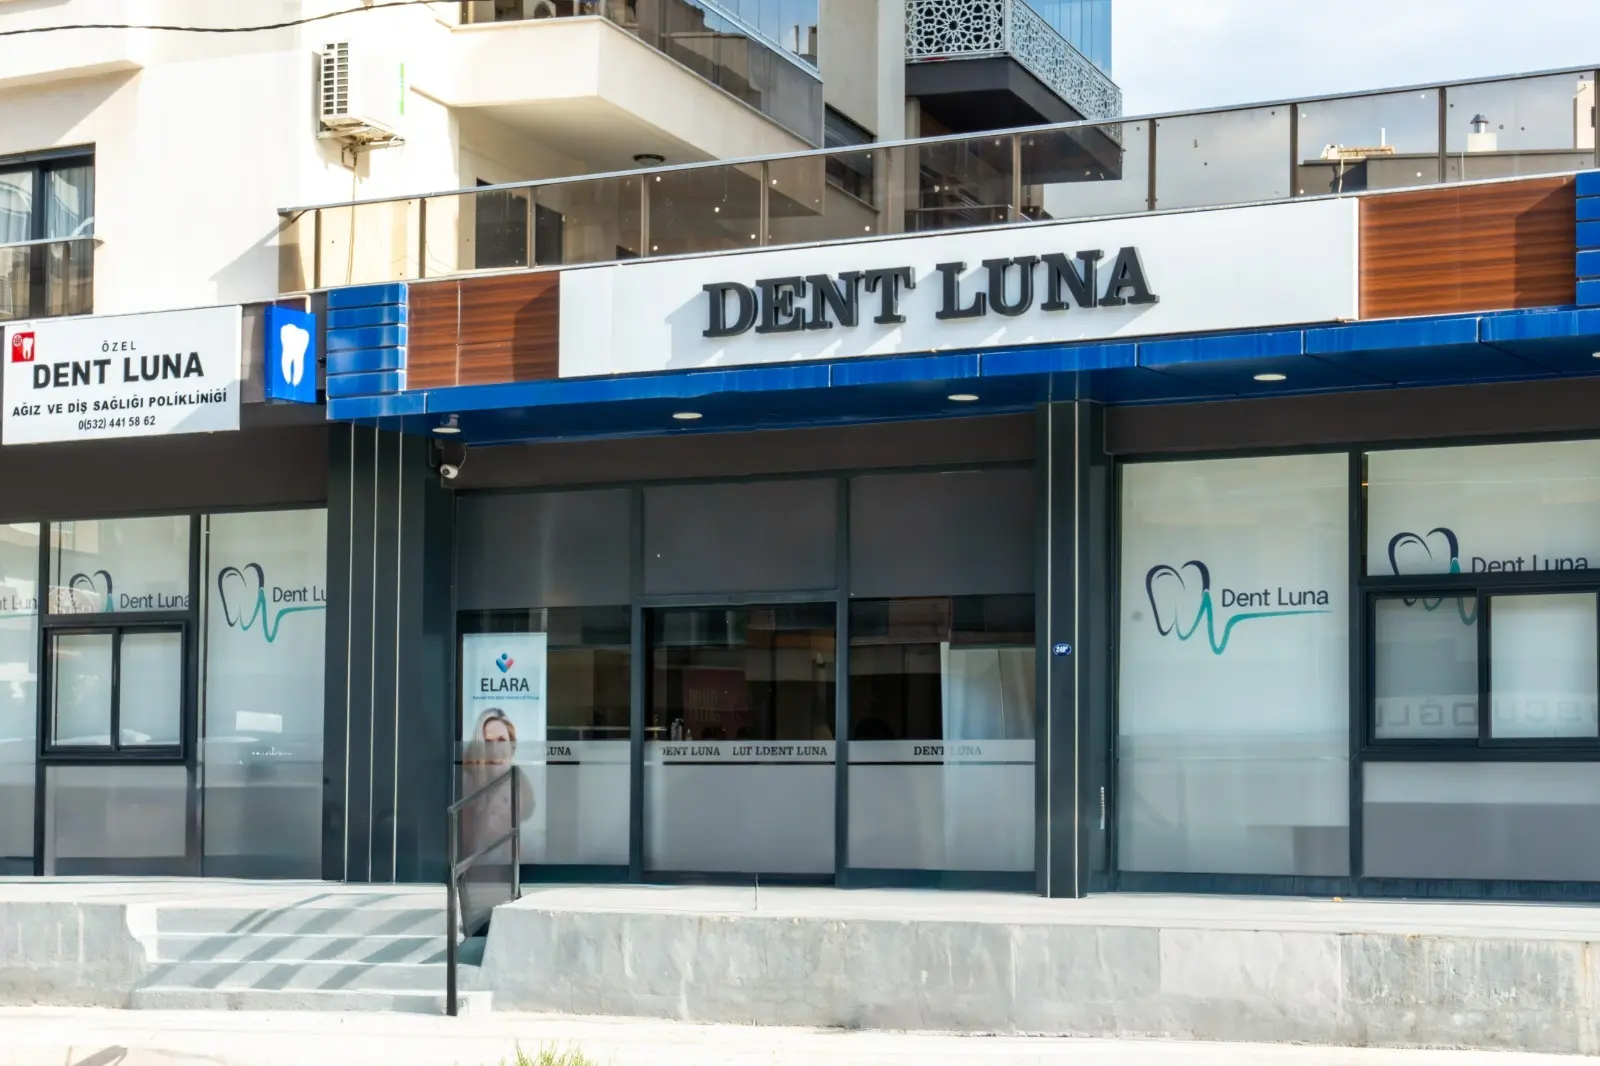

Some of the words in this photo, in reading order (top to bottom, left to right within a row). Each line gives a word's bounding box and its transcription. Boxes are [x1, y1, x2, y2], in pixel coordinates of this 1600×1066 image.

[702, 266, 916, 337] DENT
[935, 246, 1160, 320] LUNA
[101, 339, 137, 352] ÖZEL
[33, 358, 111, 390] DENT
[122, 351, 204, 383] LUNA
[12, 402, 41, 417] AĞIZ
[48, 403, 63, 414] VE
[68, 400, 88, 414] DİŞ
[93, 394, 144, 412] SAĞLIĞI
[149, 387, 228, 407] POLİKLİNİĞİ
[78, 417, 107, 431] 0(532)
[109, 417, 126, 429] 441
[128, 416, 141, 427] 58
[144, 415, 156, 426] 62
[1471, 556, 1525, 573] Dent
[12, 594, 38, 610] Lun
[120, 593, 153, 609] Dent
[158, 592, 189, 608] Luna
[273, 586, 309, 603] Dent
[313, 585, 327, 601] Lu
[1221, 588, 1271, 608] Dent
[1278, 586, 1330, 606] Luna
[481, 678, 530, 692] ELARA
[547, 747, 572, 756] UNA
[691, 746, 720, 756] LUNA
[797, 746, 827, 756] LUNA
[914, 746, 944, 756] DENT
[951, 746, 982, 756] LUNA
